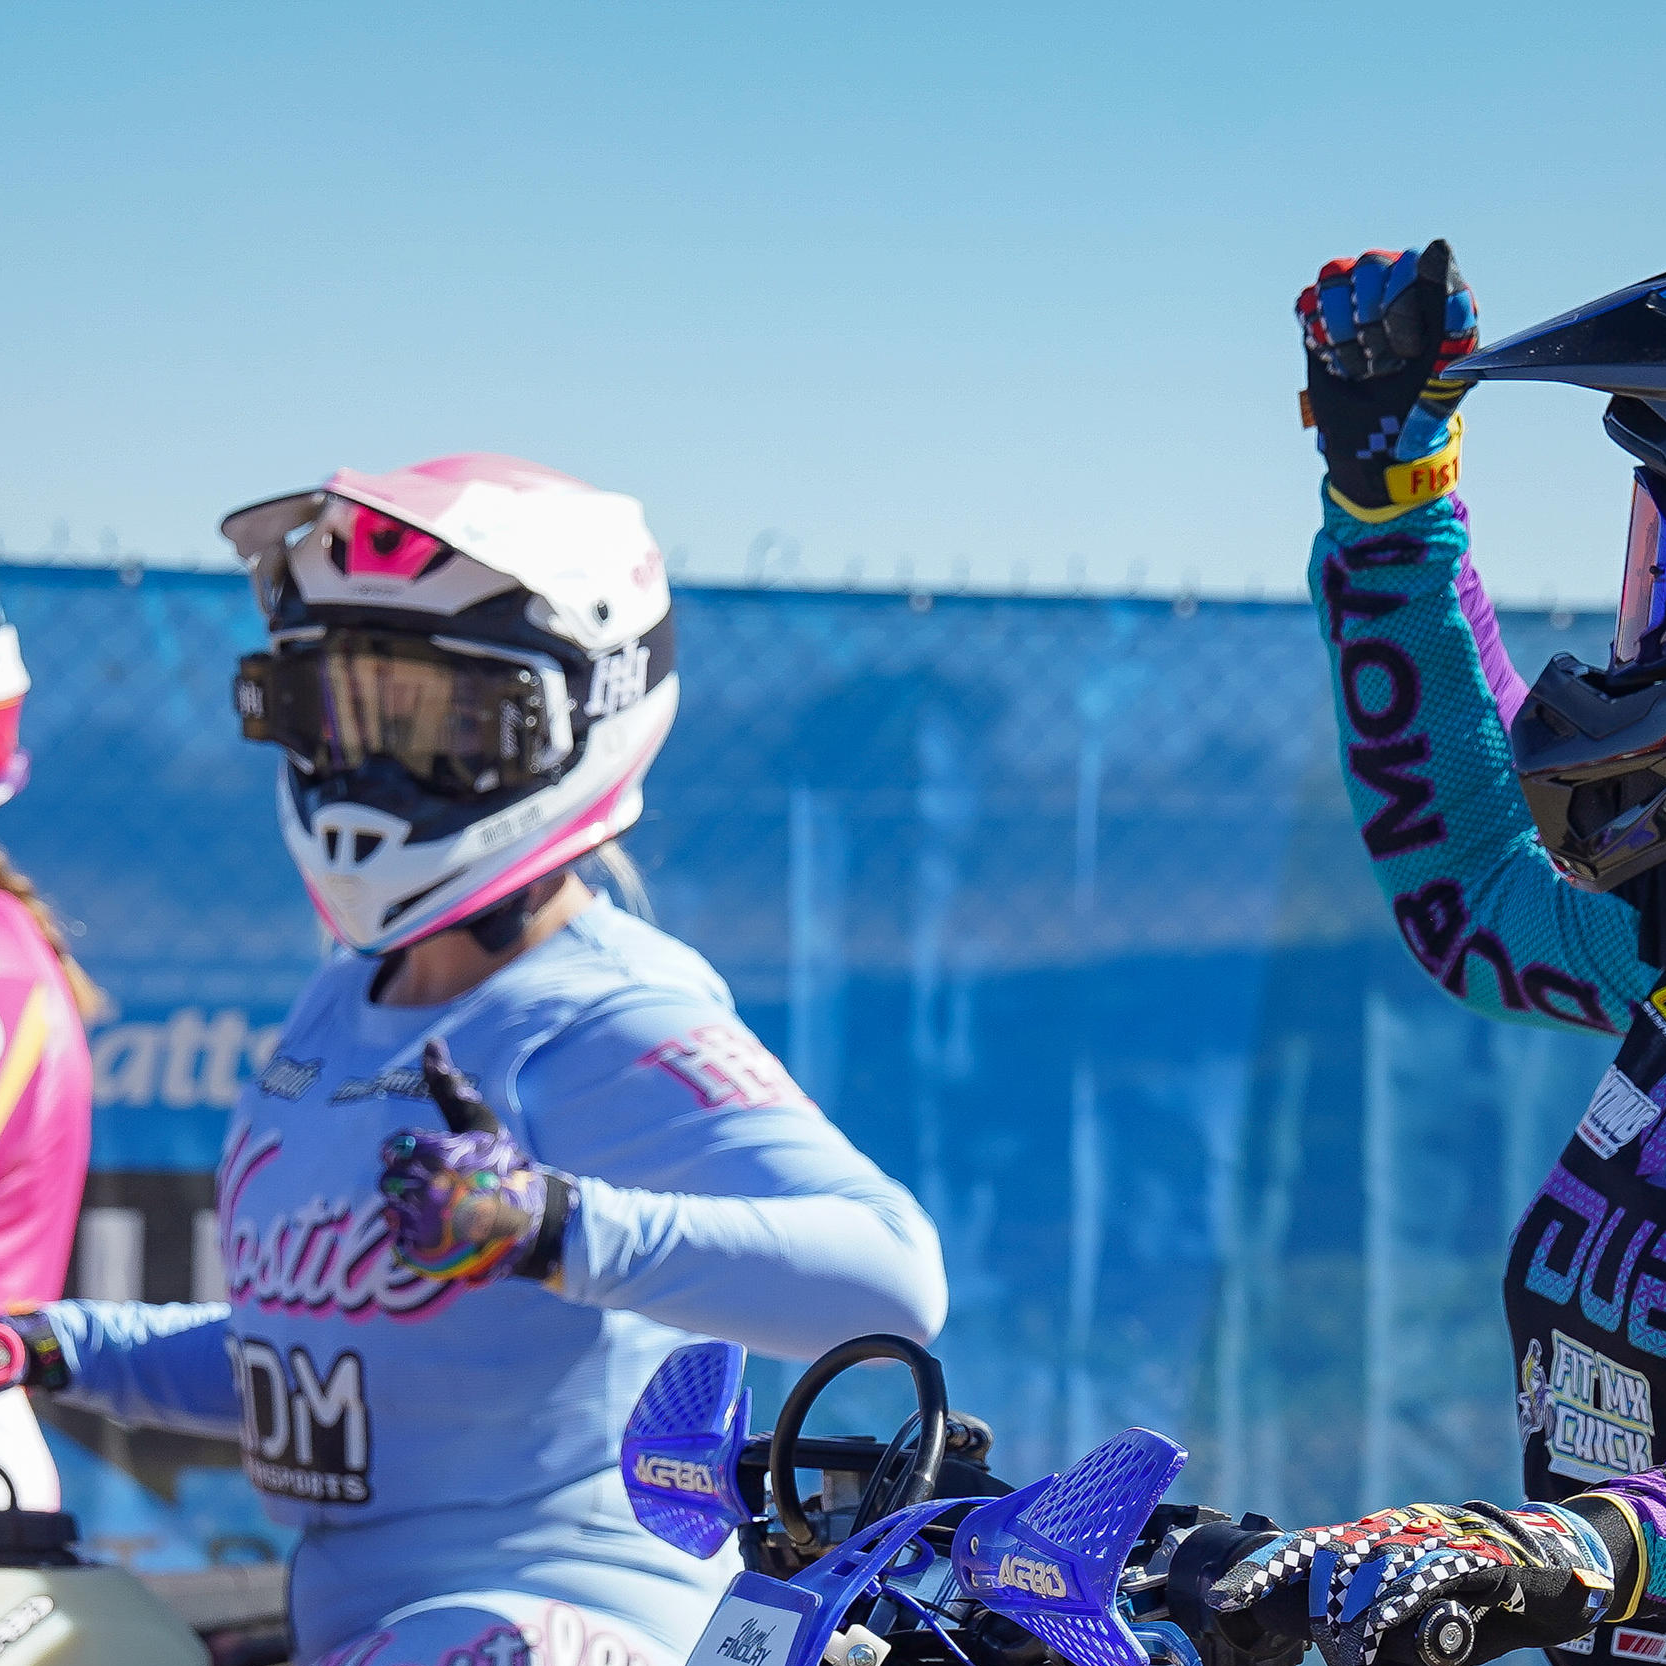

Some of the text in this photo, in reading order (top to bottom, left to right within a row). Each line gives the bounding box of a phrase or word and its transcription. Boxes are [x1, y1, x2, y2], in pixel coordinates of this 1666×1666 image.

[1553, 1347, 1650, 1422] FIT MX
[1555, 1405, 1653, 1475] CHICK
